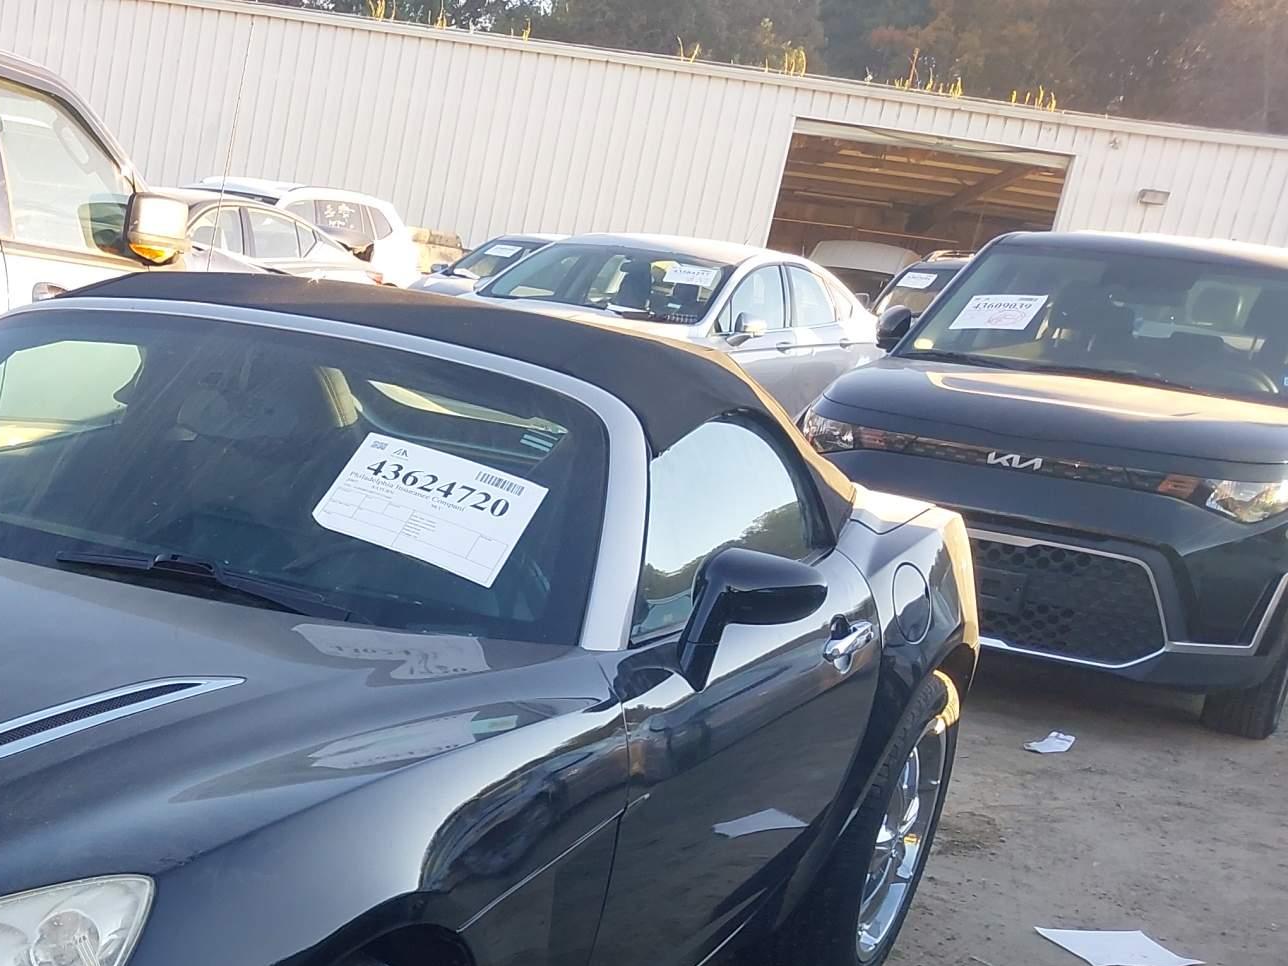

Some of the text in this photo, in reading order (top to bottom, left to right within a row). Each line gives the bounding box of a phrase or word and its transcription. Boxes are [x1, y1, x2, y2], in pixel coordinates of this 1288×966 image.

[986, 451, 1043, 471] KIA
[366, 459, 510, 517] 43624720
[394, 483, 430, 501] Insurance
